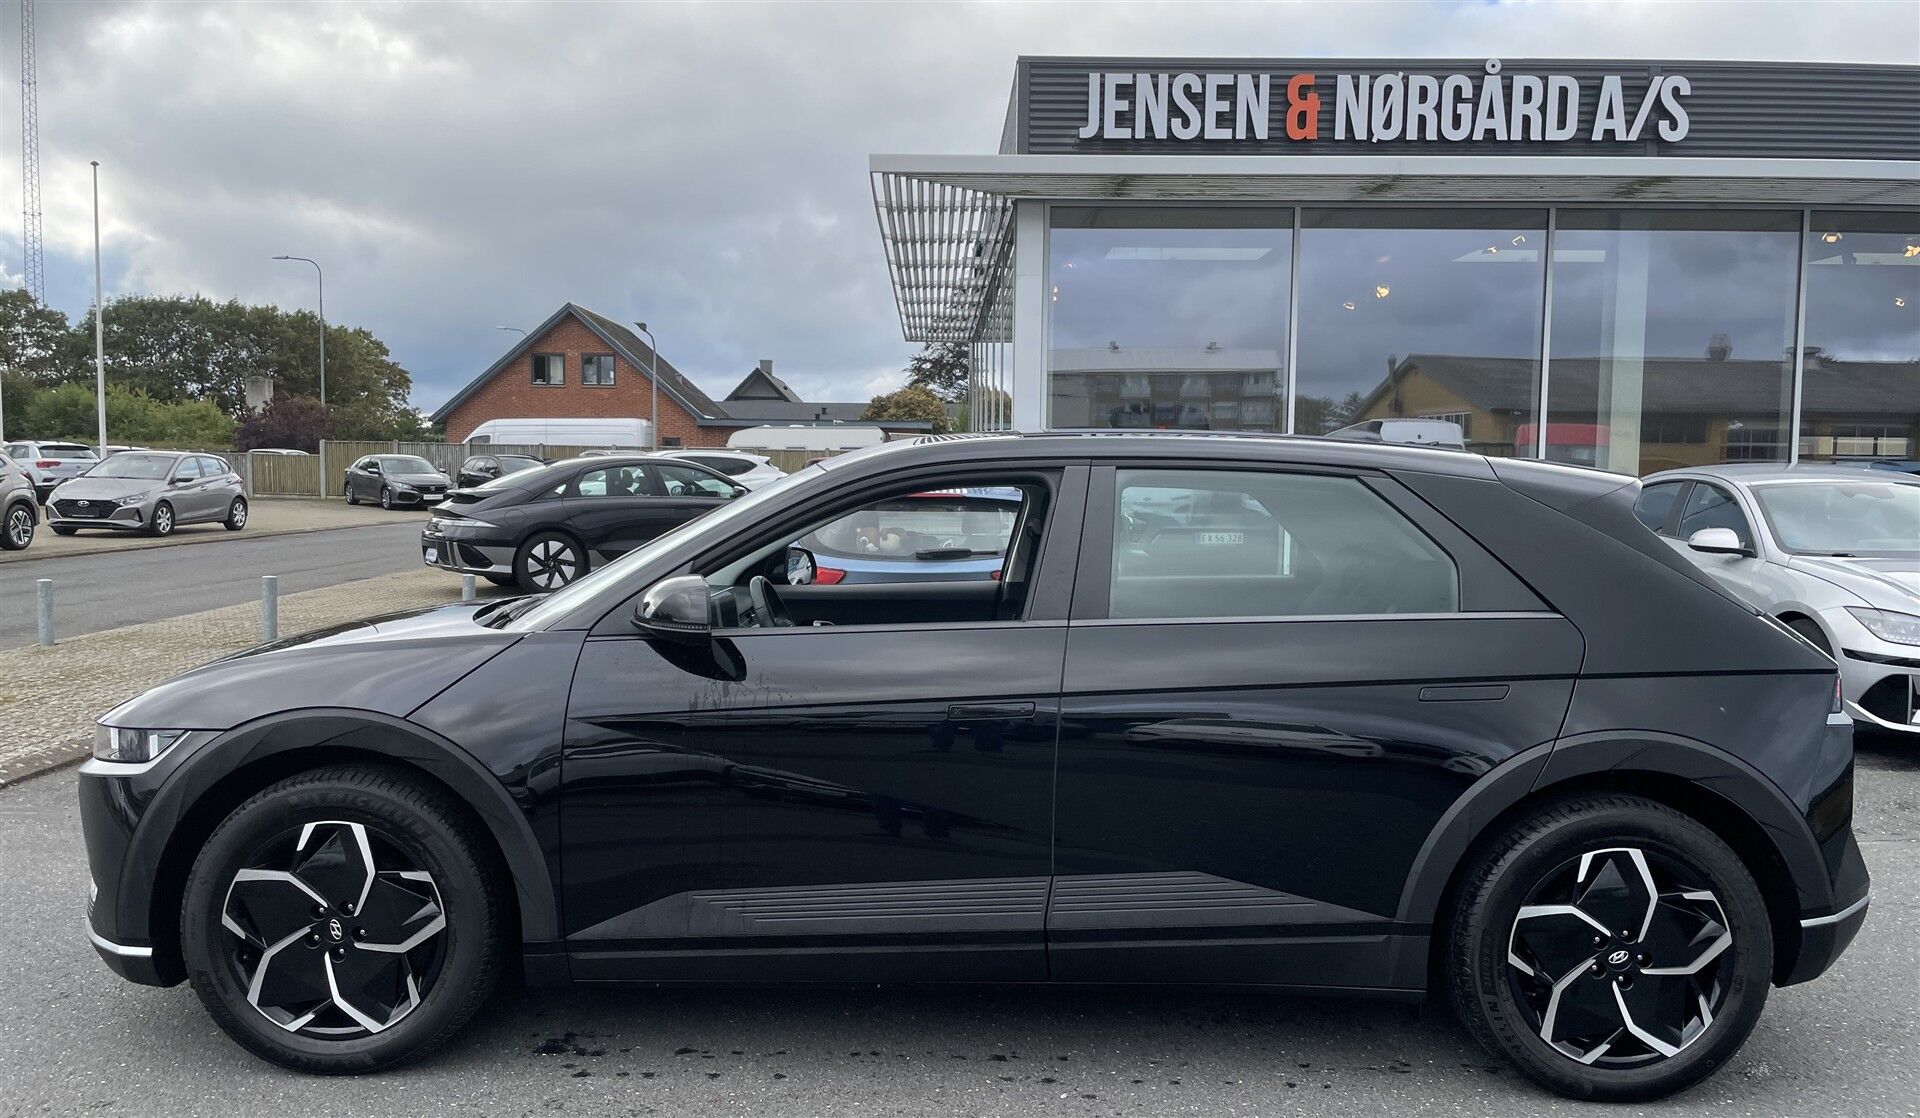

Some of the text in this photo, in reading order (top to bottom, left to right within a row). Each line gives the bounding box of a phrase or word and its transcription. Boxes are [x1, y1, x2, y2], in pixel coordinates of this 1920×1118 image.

[1079, 58, 1692, 143] JENSEN & NØRGÅRD A/S
